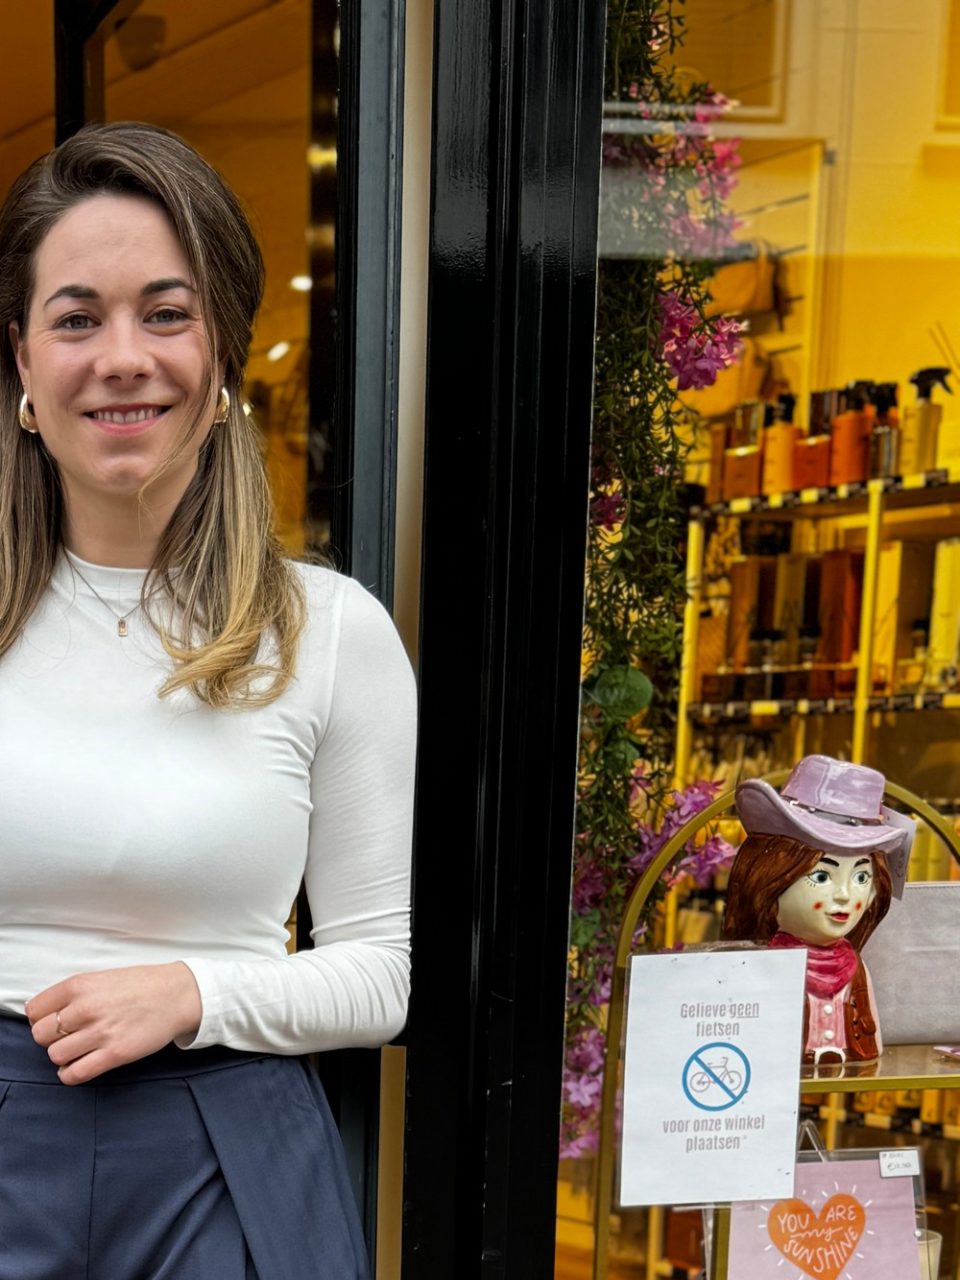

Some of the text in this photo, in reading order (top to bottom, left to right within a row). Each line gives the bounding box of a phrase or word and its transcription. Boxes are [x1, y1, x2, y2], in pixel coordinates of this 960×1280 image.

[680, 1002, 759, 1018] Gelieve geen
[696, 1020, 739, 1036] fietsen
[663, 1114, 765, 1133] voor onze winkel
[686, 1135, 741, 1153] plaatsen
[777, 1204, 857, 1233] YOU ARE
[790, 1226, 843, 1242] my
[784, 1226, 859, 1273] SUNSHINE
